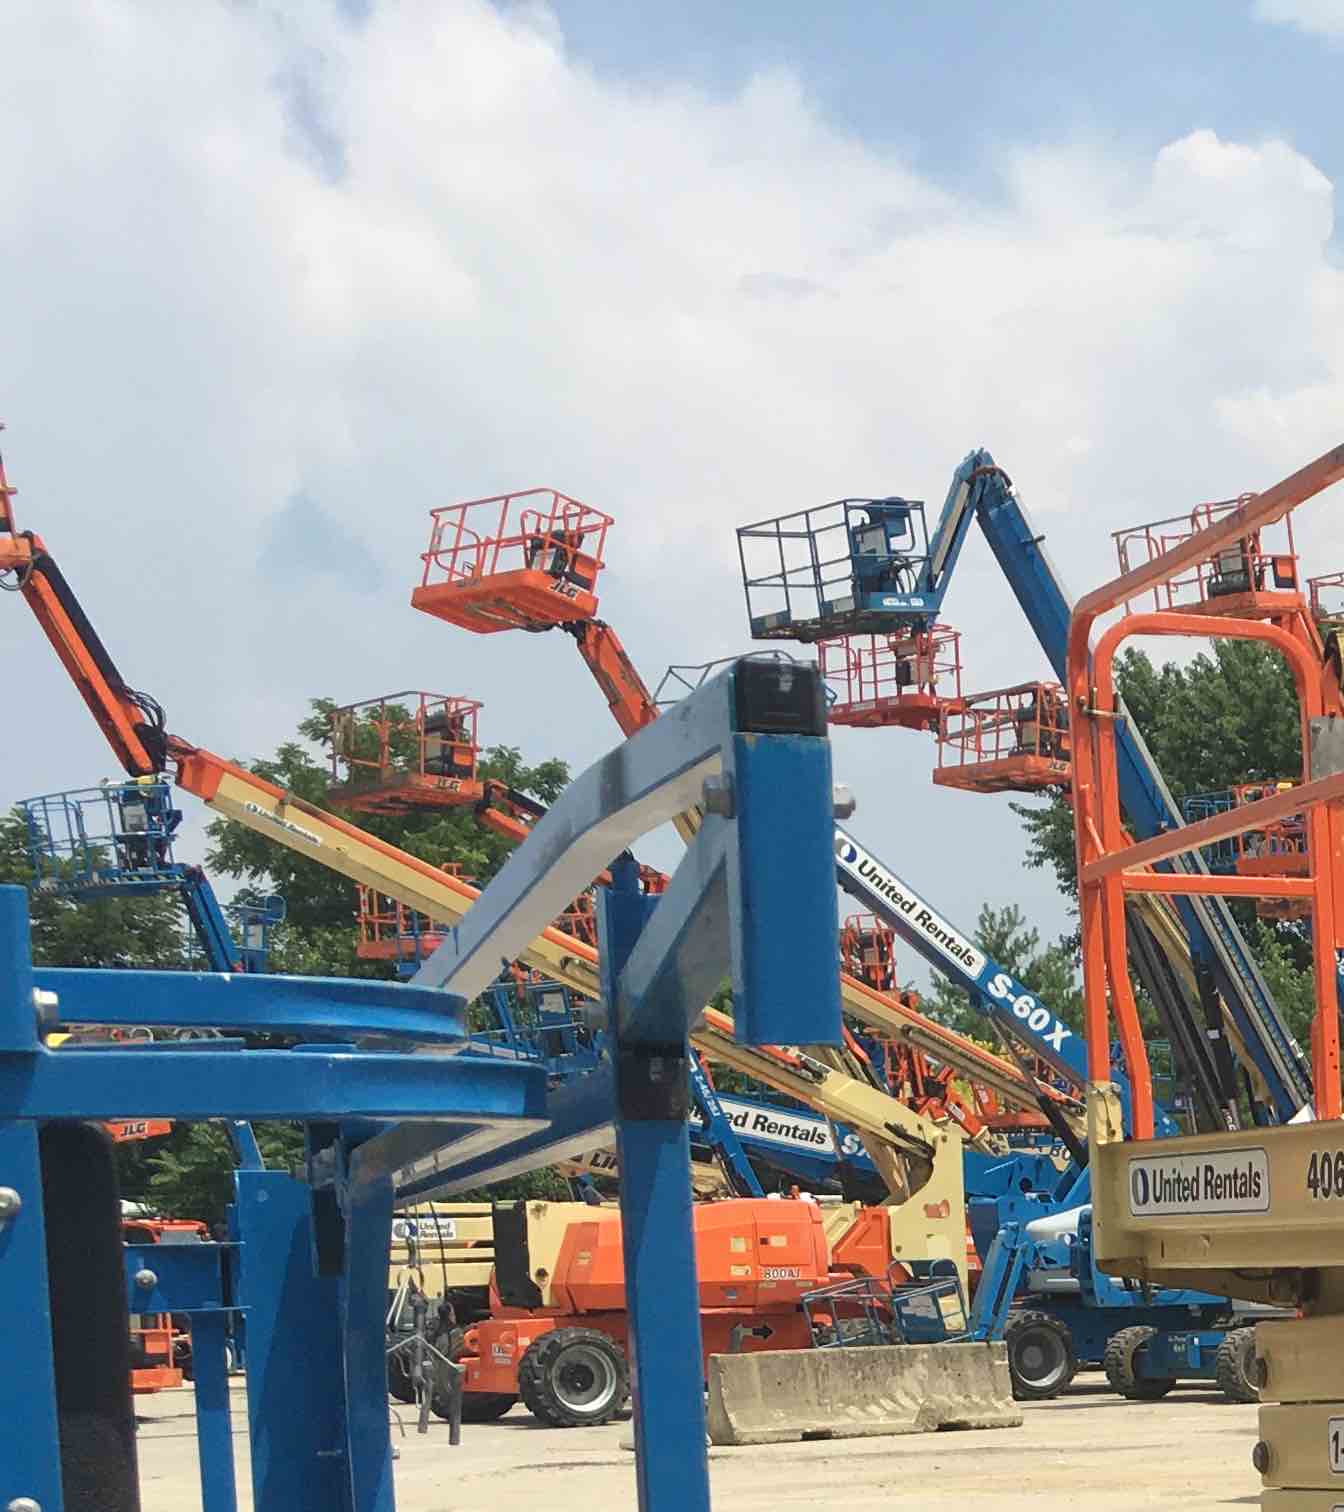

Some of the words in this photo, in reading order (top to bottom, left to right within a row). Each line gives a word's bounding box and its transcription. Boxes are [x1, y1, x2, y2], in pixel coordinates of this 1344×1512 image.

[859, 859, 915, 914] United
[914, 908, 976, 968] Rentals
[987, 973, 1072, 1052] S-60X
[752, 1113, 827, 1145] Rentals
[1152, 1166, 1200, 1204] United
[1203, 1161, 1262, 1200] Rentals
